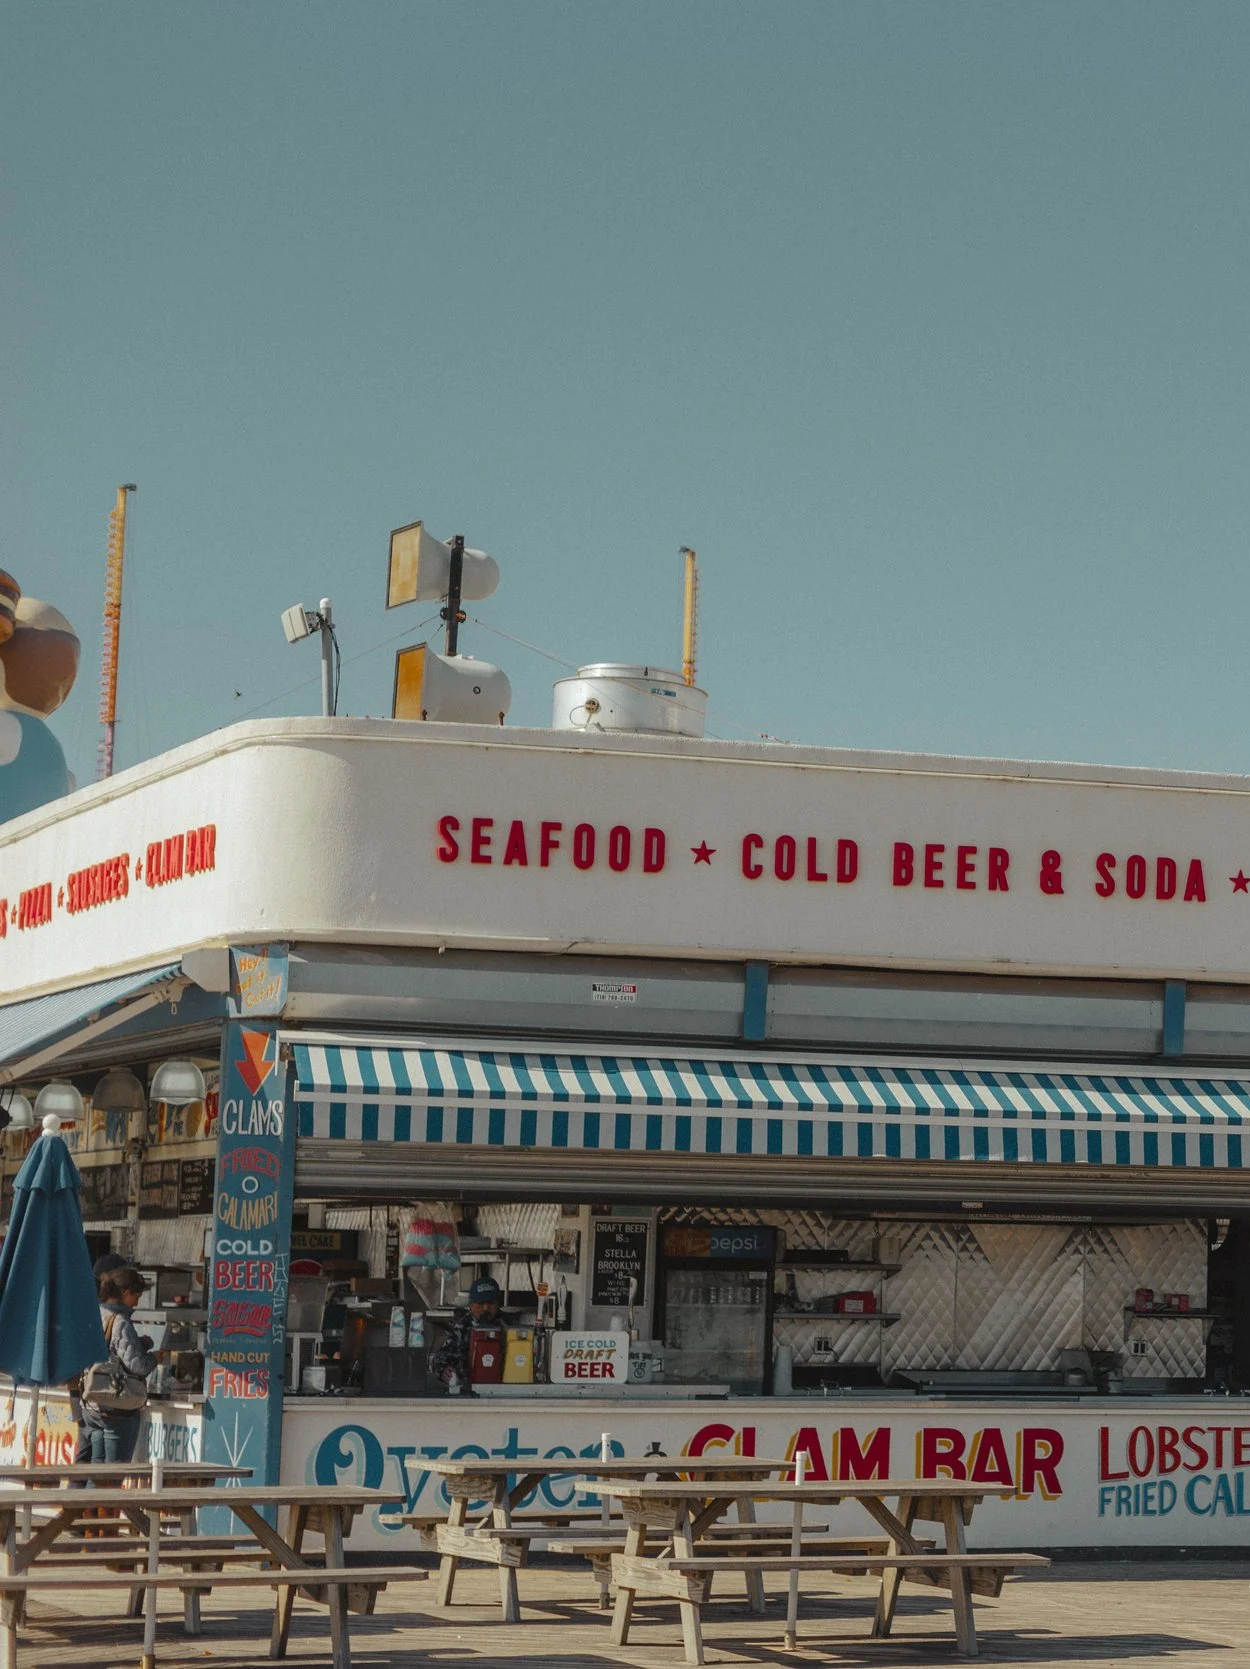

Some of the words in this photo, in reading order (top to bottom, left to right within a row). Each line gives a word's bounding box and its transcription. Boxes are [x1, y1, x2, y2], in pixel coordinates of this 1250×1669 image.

[436, 815, 666, 873] SEAFOOD
[741, 833, 859, 884] COLD
[892, 842, 1009, 892] BEER
[1039, 849, 1064, 895] &
[1095, 852, 1207, 903] SODA
[18, 882, 52, 931] PIZZA
[66, 853, 130, 915] SAUSAGES
[145, 834, 184, 889] CLAM
[184, 824, 216, 876] BAR
[222, 1099, 283, 1136] CLAMS
[220, 1146, 281, 1182] FRIED
[217, 1192, 278, 1232] CALAMARI
[597, 1224, 623, 1232] DRAFT
[625, 1224, 645, 1233] BEER
[216, 1239, 273, 1255] COLD
[604, 1249, 637, 1258] STELLA
[214, 1260, 274, 1292] BEER
[598, 1260, 640, 1270] BROOKLYN
[211, 1351, 245, 1363] HAND
[247, 1352, 270, 1363] CUT
[563, 1349, 616, 1360] DRAFT
[565, 1340, 584, 1348] ICE
[587, 1340, 616, 1348] COLD
[208, 1368, 269, 1399] FRIES
[564, 1362, 615, 1378] BEER
[916, 1427, 1064, 1501] BAR
[1099, 1480, 1177, 1517] FRIED
